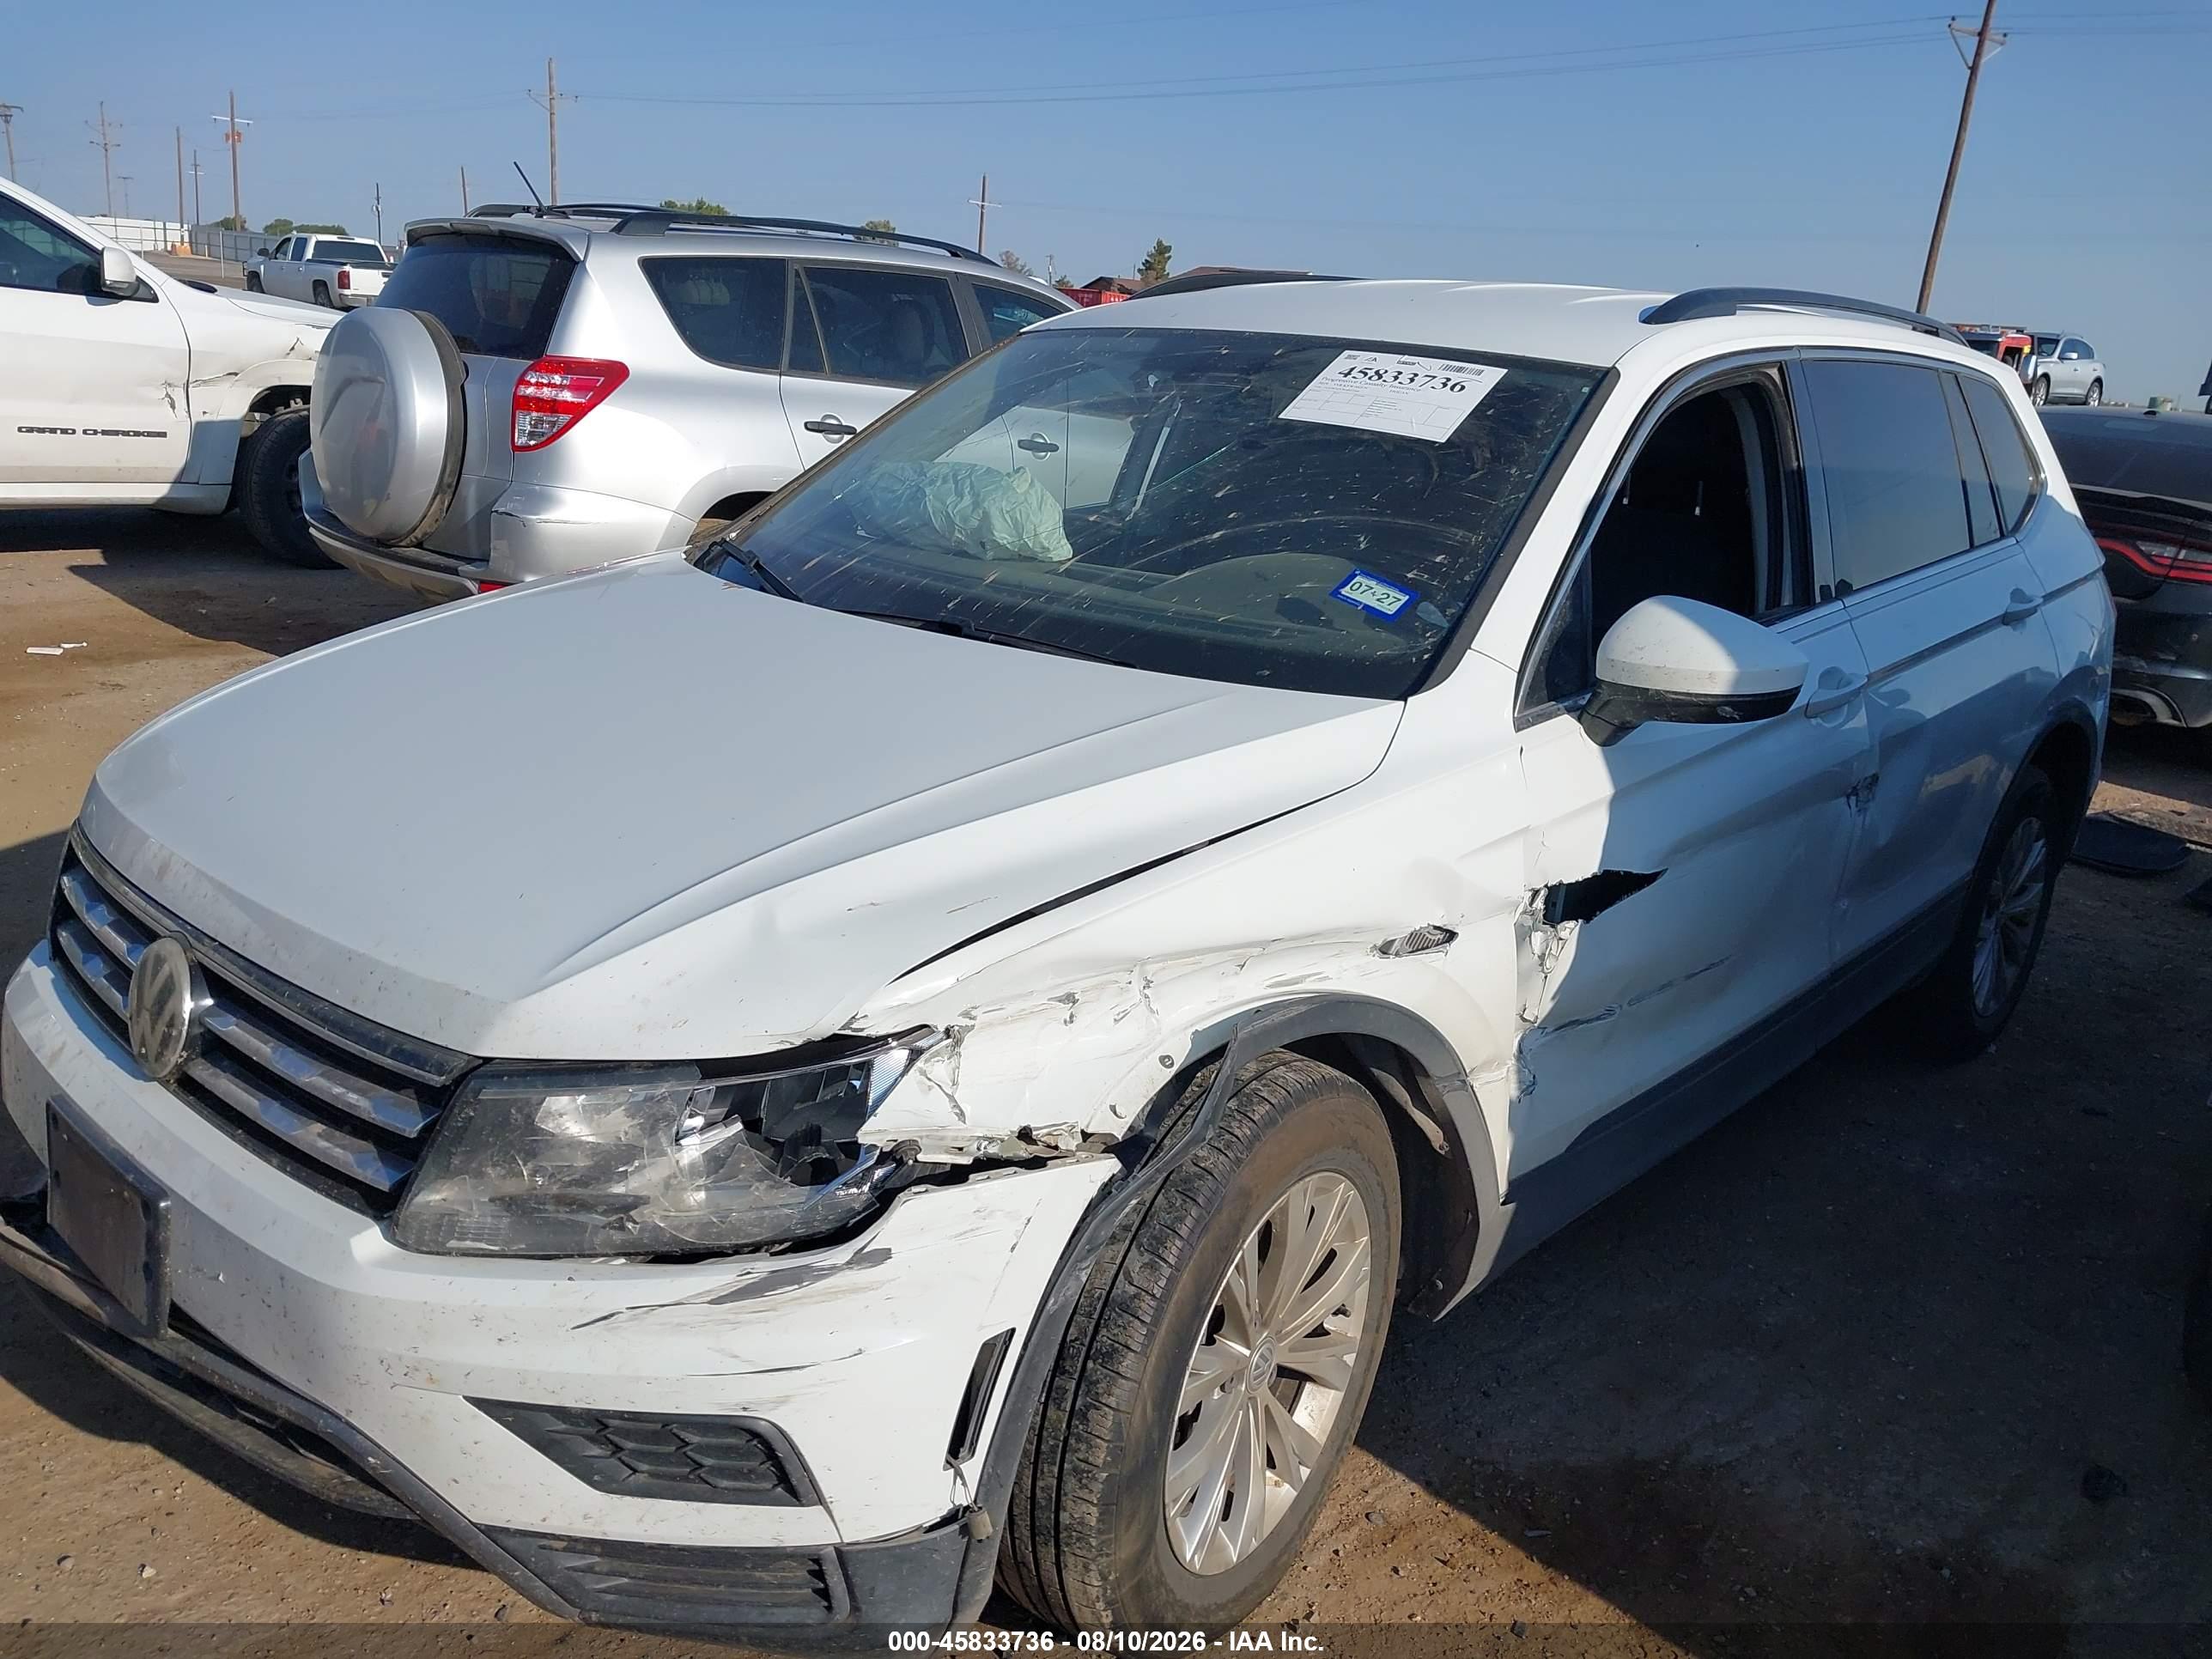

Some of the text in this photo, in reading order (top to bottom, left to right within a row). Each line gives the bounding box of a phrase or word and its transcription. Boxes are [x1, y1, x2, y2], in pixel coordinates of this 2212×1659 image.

[1338, 366, 1472, 392] 45833736
[17, 426, 76, 435] GRAND
[1349, 581, 1374, 595] 07
[1376, 592, 1402, 606] 27
